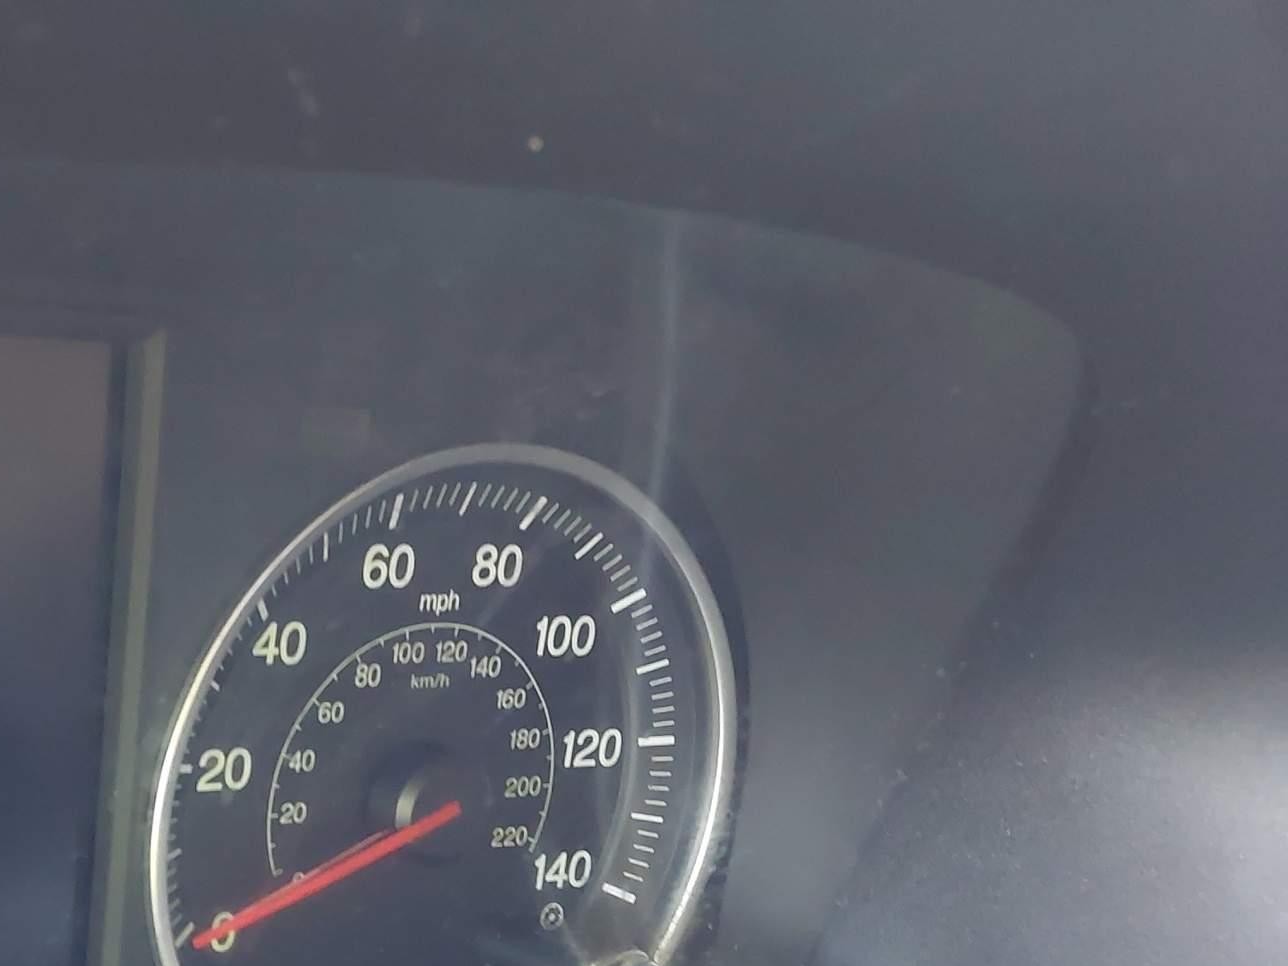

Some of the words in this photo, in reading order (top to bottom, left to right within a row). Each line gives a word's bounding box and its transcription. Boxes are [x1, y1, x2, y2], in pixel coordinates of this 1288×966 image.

[362, 543, 415, 589] 60
[472, 543, 523, 588] 80
[419, 591, 460, 614] mph
[252, 620, 308, 666] 40
[536, 614, 596, 657] 100
[392, 642, 424, 664] 100
[436, 640, 467, 664] 120
[354, 663, 381, 688] 80
[470, 656, 501, 679] 140
[411, 674, 450, 689] km/h
[496, 688, 526, 710] 160
[318, 702, 344, 724] 60
[510, 726, 540, 750] 180
[563, 728, 622, 768] 120
[196, 747, 252, 792] 20
[289, 754, 315, 773] 40
[504, 780, 541, 798] 200
[280, 802, 307, 825] 20
[490, 829, 528, 849] 220
[534, 850, 592, 890] 140
[211, 911, 235, 952] 0
